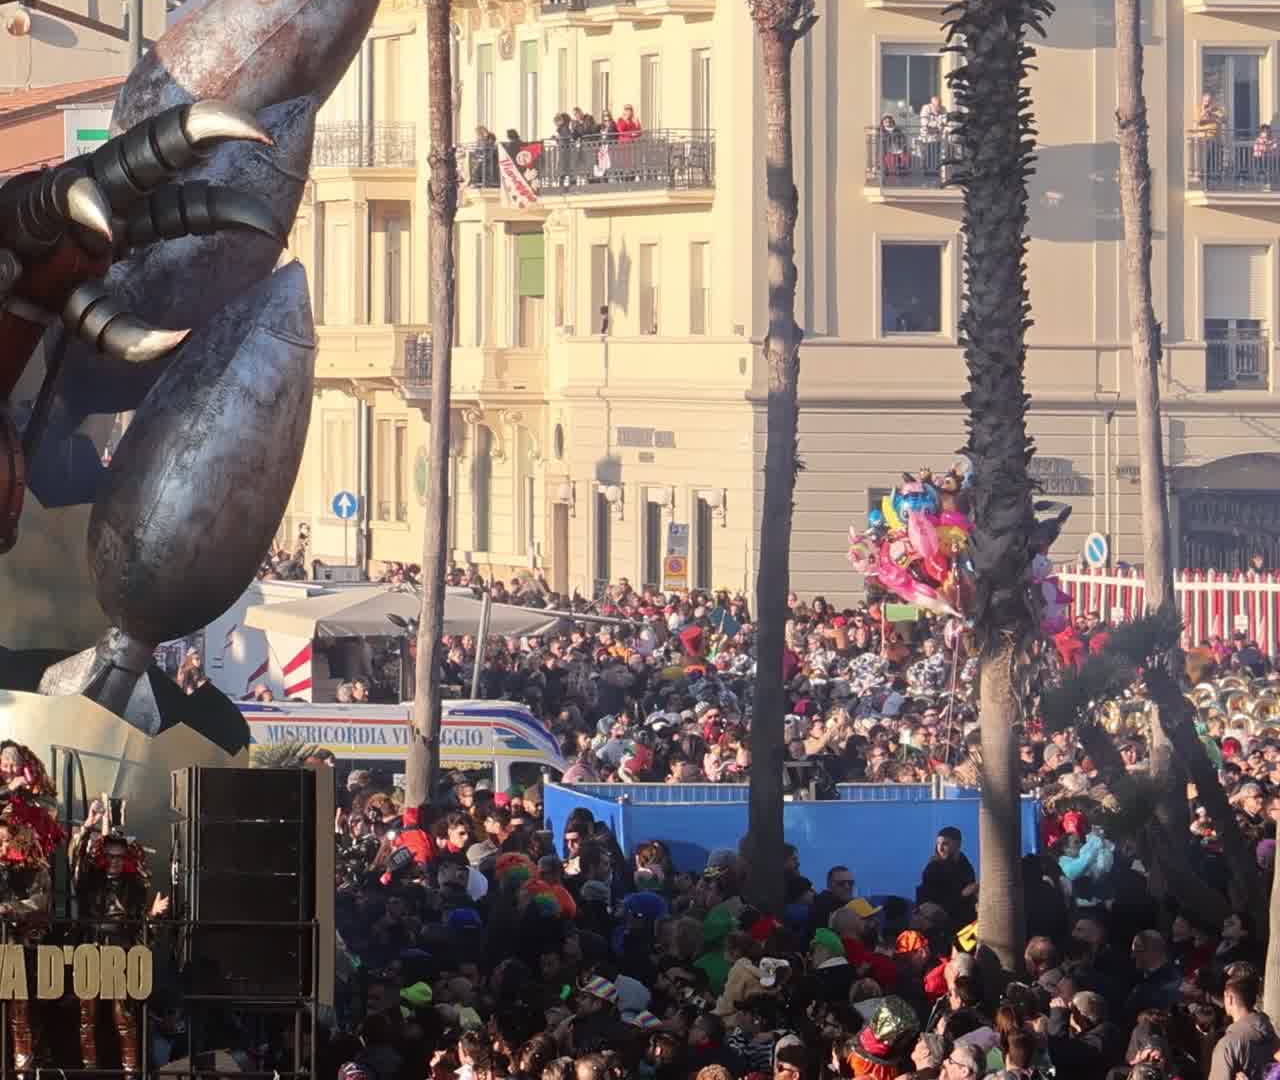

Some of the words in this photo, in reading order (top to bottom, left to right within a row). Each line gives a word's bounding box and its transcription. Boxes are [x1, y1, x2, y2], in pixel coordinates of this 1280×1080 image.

[267, 724, 387, 745] MISERICORDIA
[391, 726, 483, 746] VIGGIO
[37, 943, 153, 1000] D'ORO
